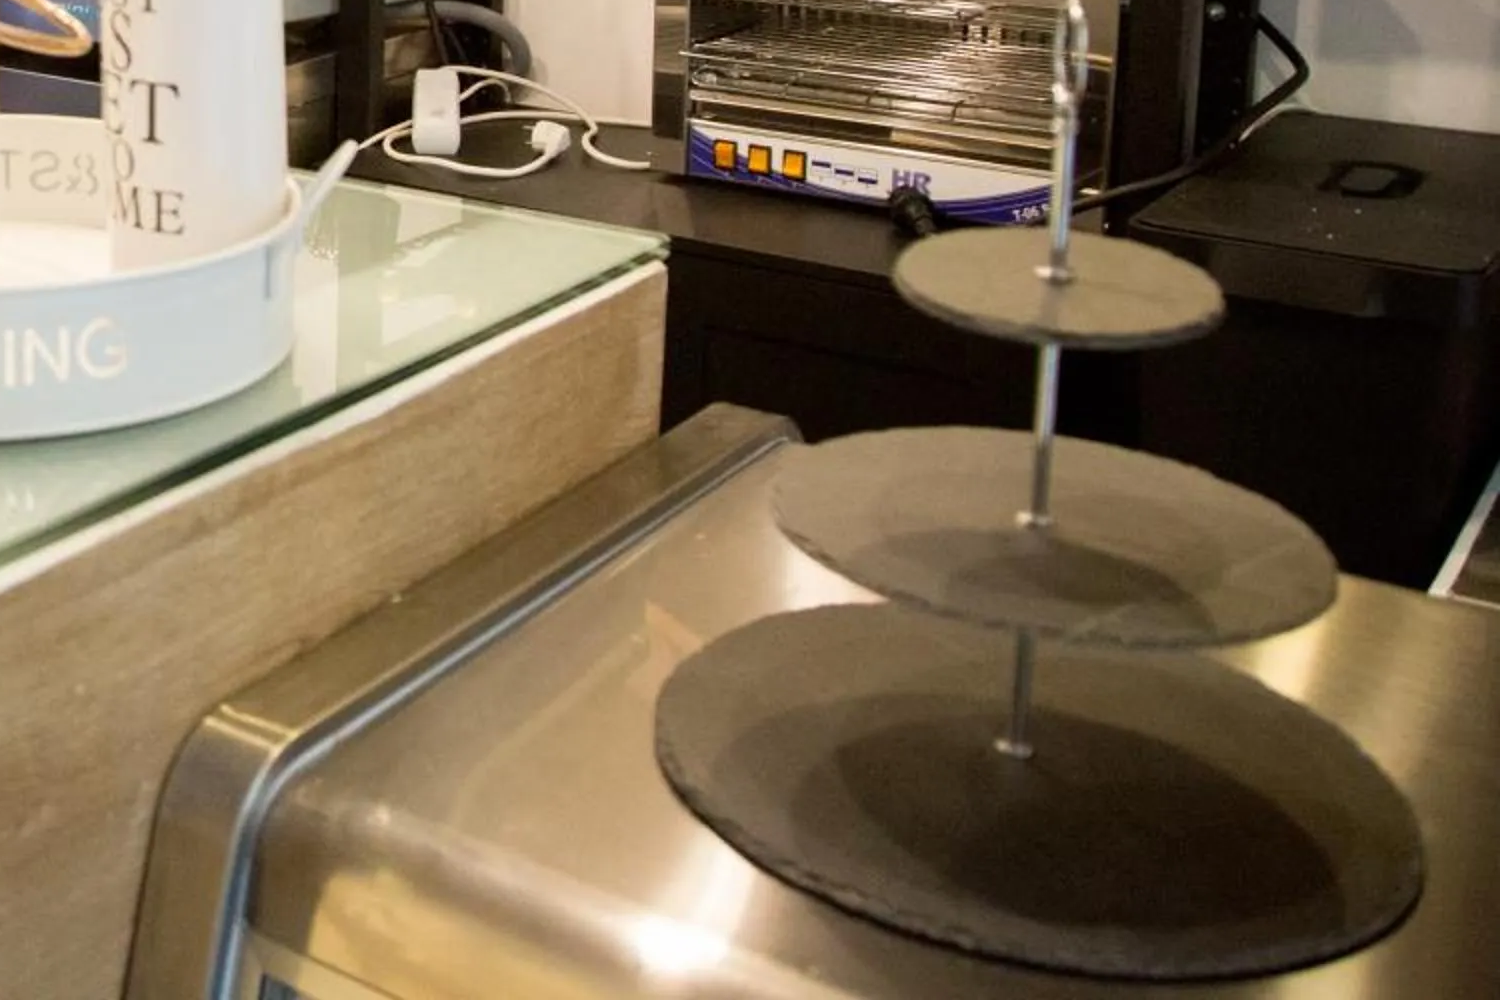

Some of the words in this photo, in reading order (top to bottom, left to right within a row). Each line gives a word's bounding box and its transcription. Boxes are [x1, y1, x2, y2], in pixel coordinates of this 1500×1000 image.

[109, 8, 132, 74] S
[103, 70, 181, 145] ET
[111, 137, 135, 181] O
[111, 179, 186, 236] ME
